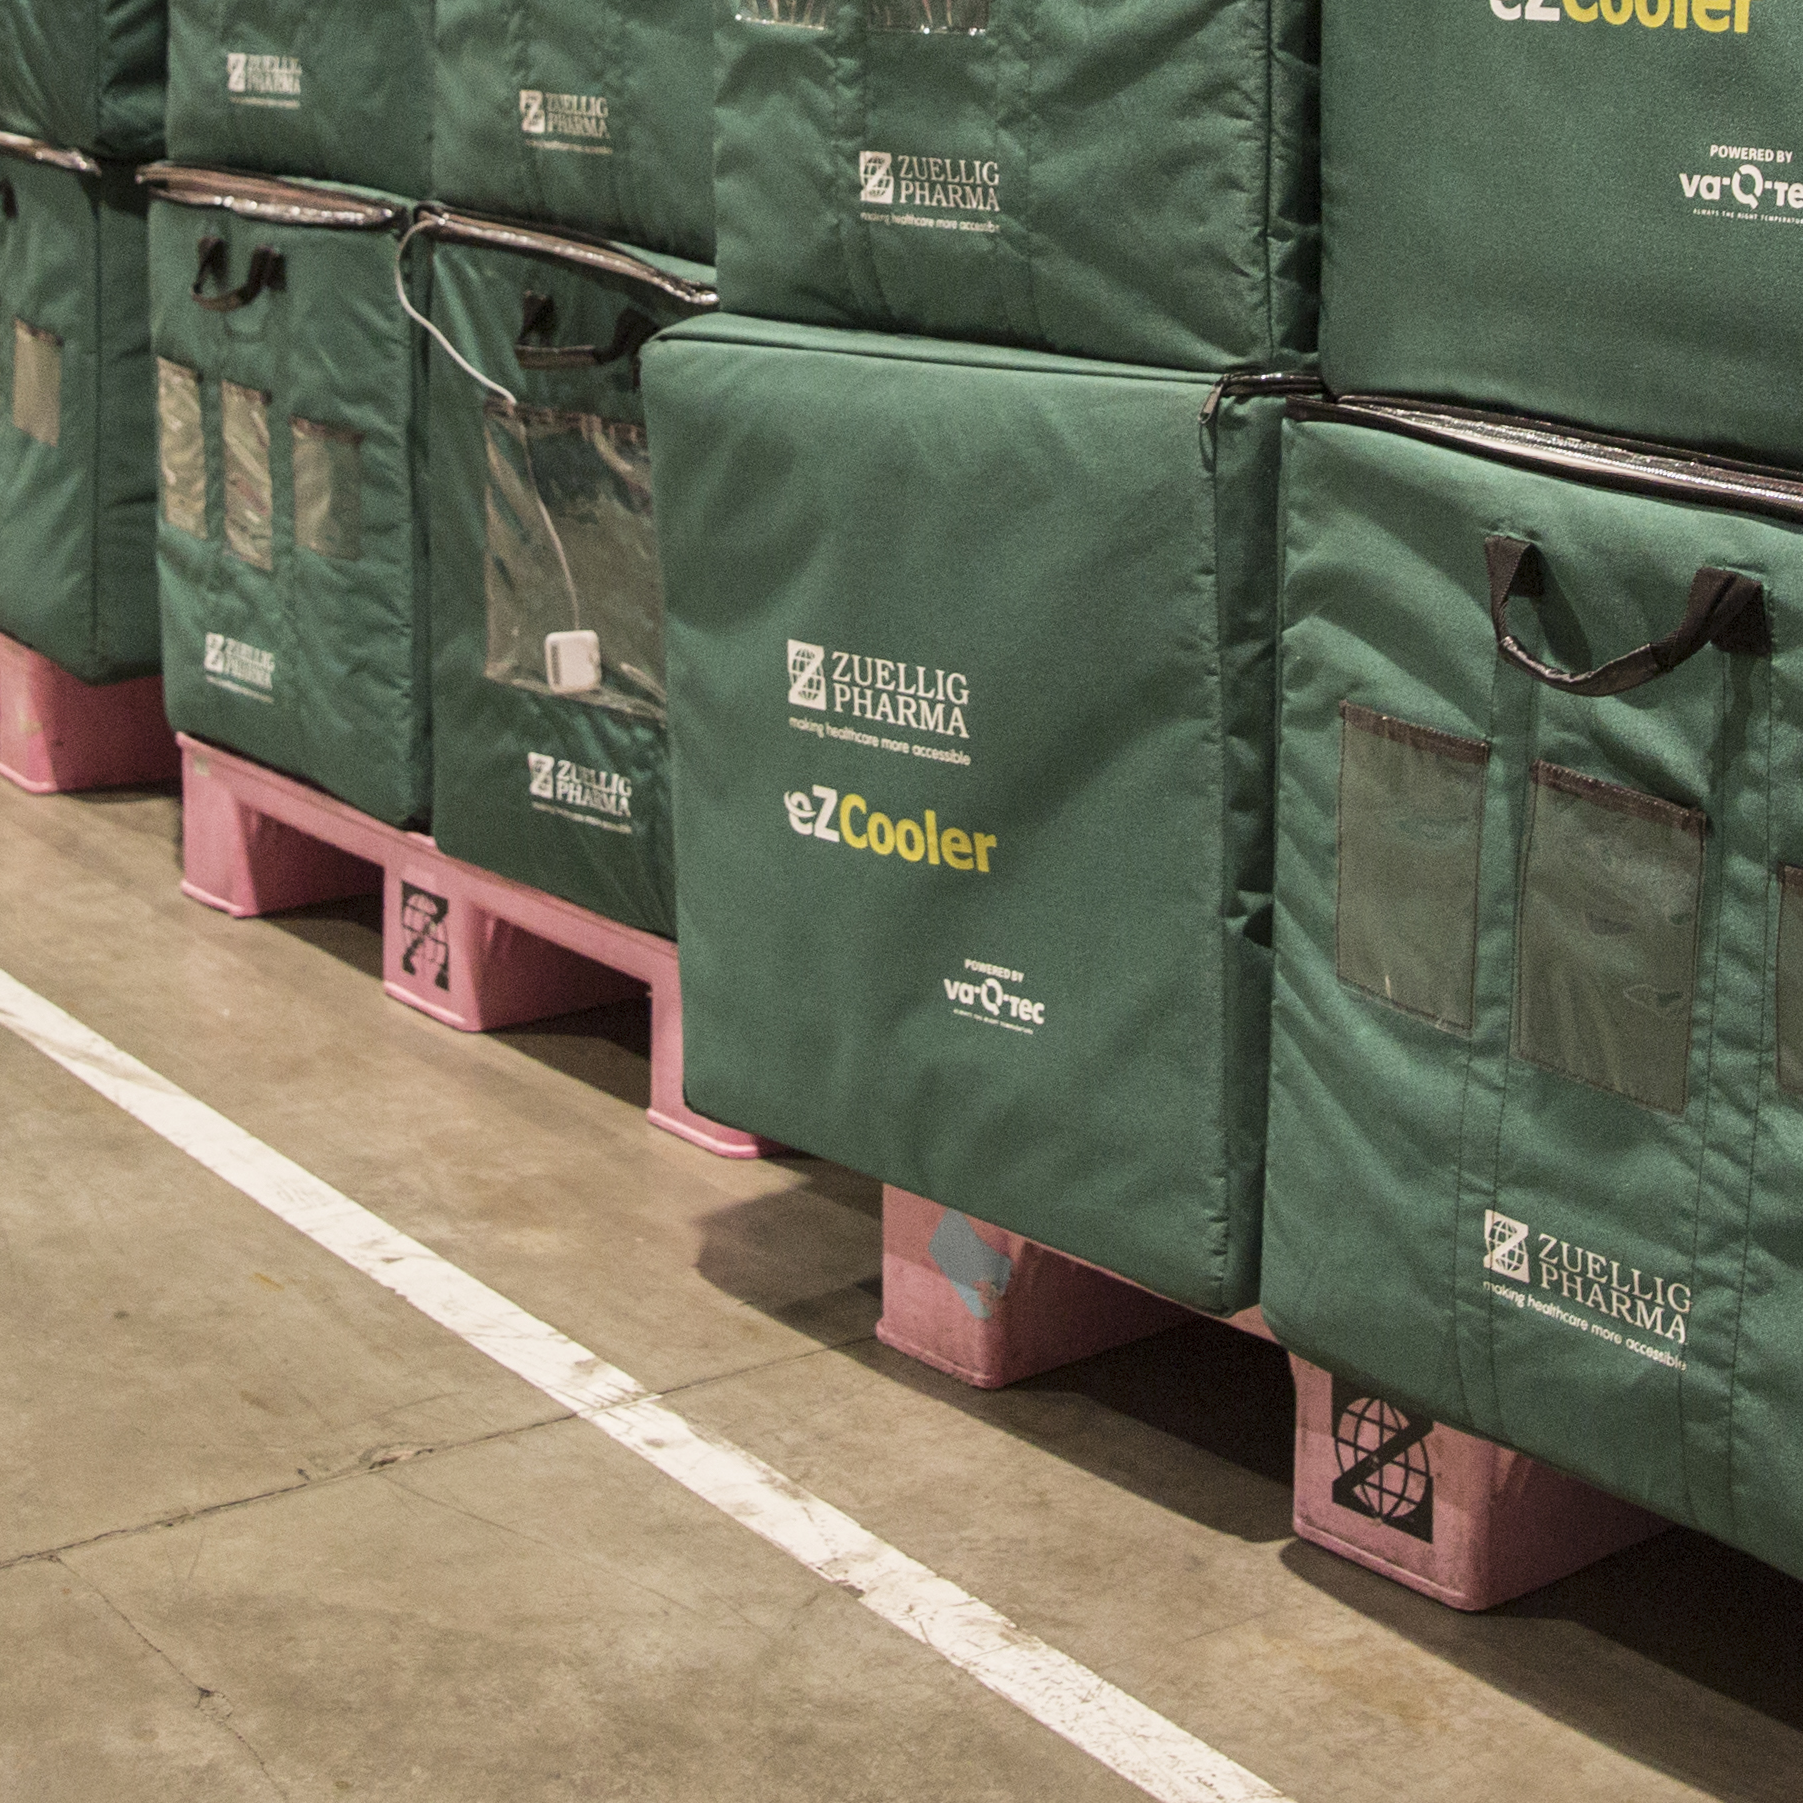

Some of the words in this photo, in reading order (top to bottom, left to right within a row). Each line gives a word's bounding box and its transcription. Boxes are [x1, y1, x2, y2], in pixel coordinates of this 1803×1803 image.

[898, 155, 1000, 186] ZUELLIG
[1709, 144, 1775, 162] POWERED
[1776, 149, 1793, 164] BY
[899, 180, 1000, 212] PHARMA
[831, 651, 971, 705] ZUELLIG
[832, 684, 970, 739] PHARMA
[1538, 1233, 1692, 1314] ZUELLIG
[1483, 1280, 1525, 1309] making
[1527, 1293, 1588, 1331] healthcare
[1591, 1322, 1623, 1345] more
[1539, 1261, 1688, 1345] PHARMA
